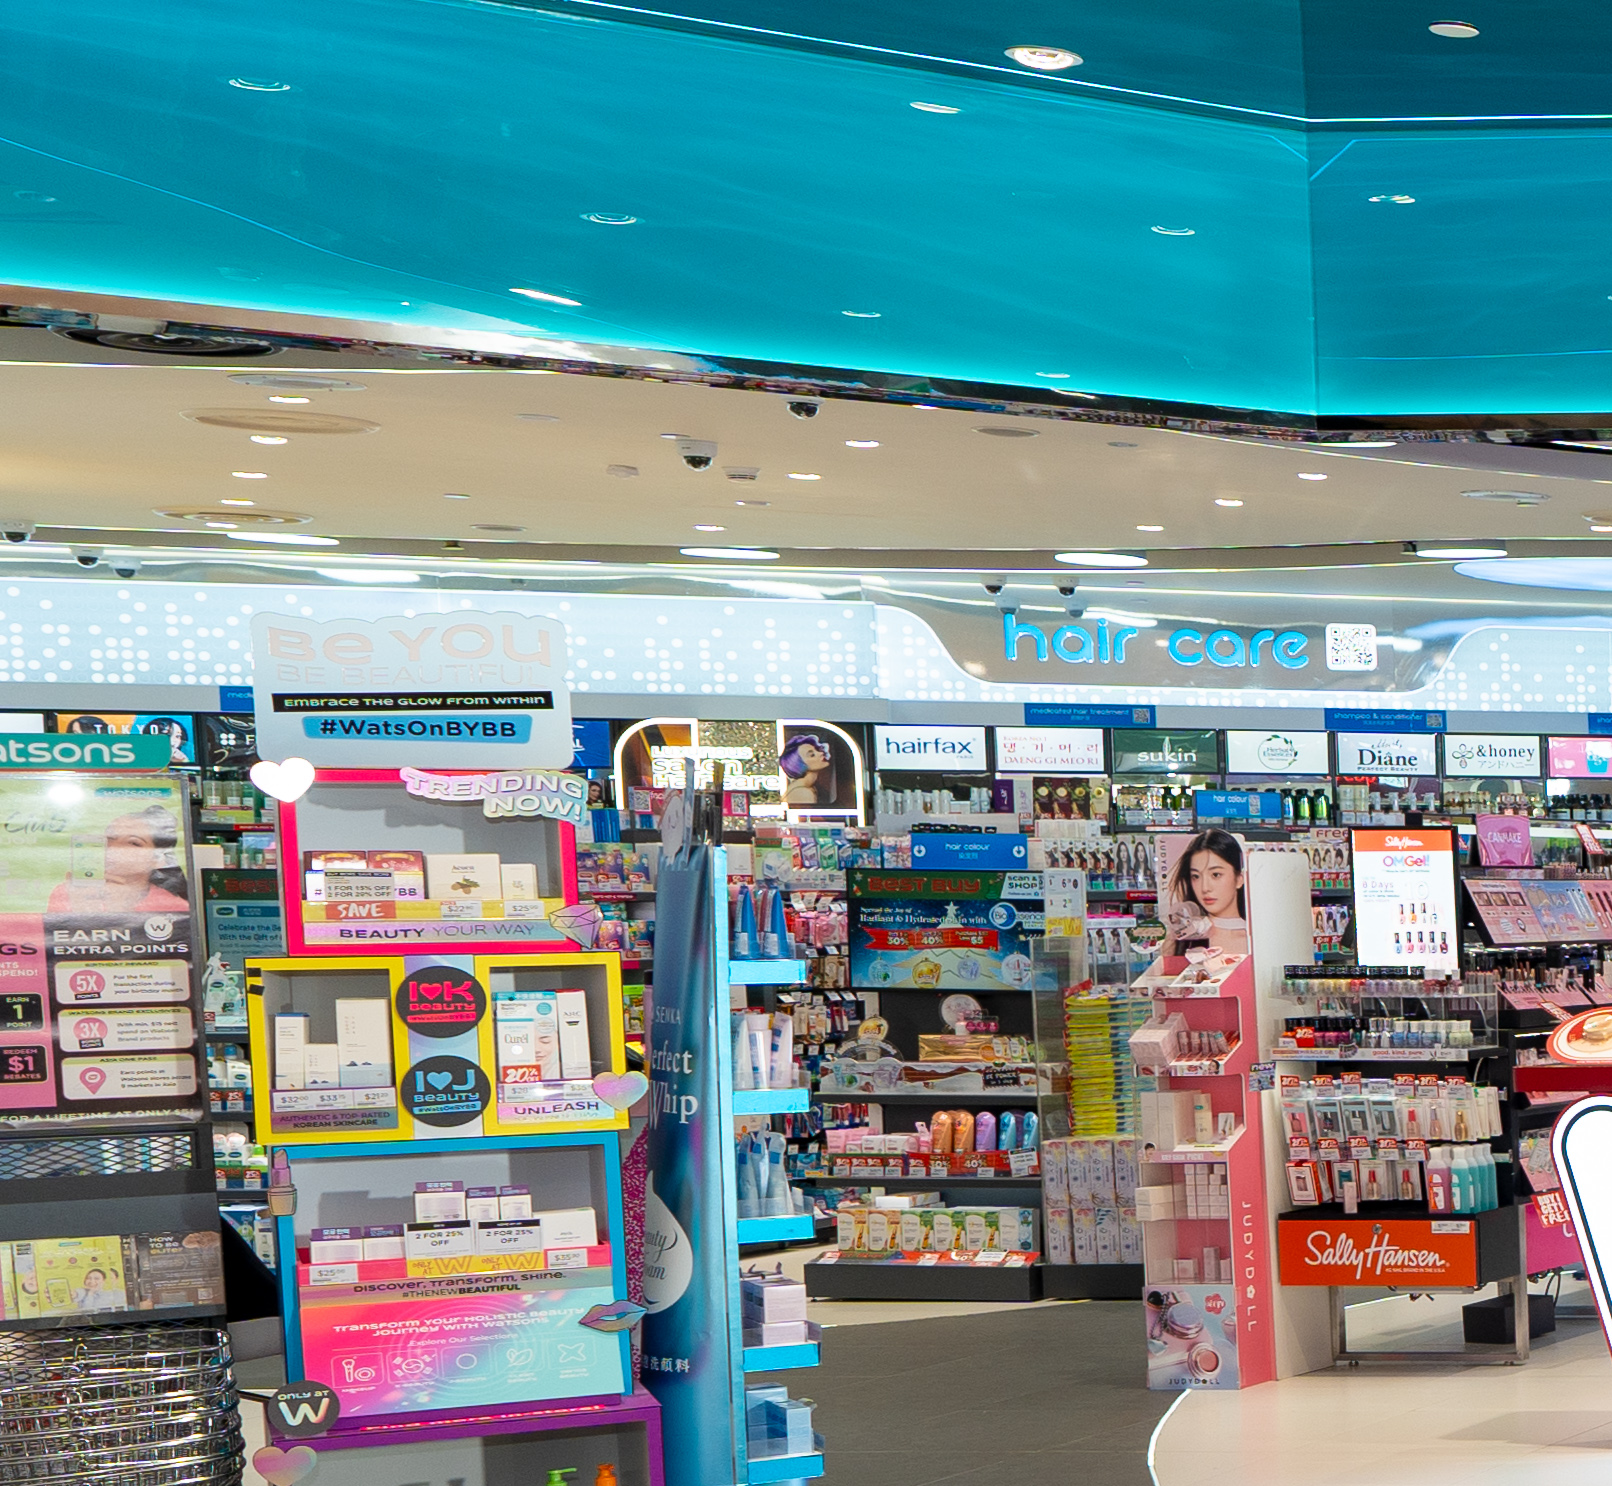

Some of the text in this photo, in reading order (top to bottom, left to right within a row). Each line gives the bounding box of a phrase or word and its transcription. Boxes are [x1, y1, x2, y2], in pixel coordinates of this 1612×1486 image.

[1003, 612, 1310, 670] hair care
[277, 663, 548, 687] BE BEAUTIFUL
[320, 719, 516, 737] #WatsOnBYBB
[885, 737, 972, 756] hairfax
[1003, 755, 1099, 766] DAENG GI MEO RI
[1137, 750, 1197, 765] sukin
[407, 773, 583, 800] TRENDING
[490, 795, 581, 821] NOW!
[945, 842, 962, 850] hair
[1488, 832, 1522, 845] CANMAKE
[337, 902, 384, 918] SAVE
[54, 929, 130, 942] EARN
[339, 924, 535, 939] BEAUTY YOUR WAY
[54, 944, 189, 954] EXTRA POINTS
[76, 975, 97, 991] 5X
[80, 1022, 100, 1038] 3X
[9, 1056, 34, 1073] $1
[513, 1100, 600, 1117] UNLEASH
[430, 1238, 449, 1247] OFF
[1304, 1231, 1446, 1279] Sally Hansen
[402, 1283, 521, 1298] #THENEWBEAUTIFUL
[278, 1397, 330, 1427] W
